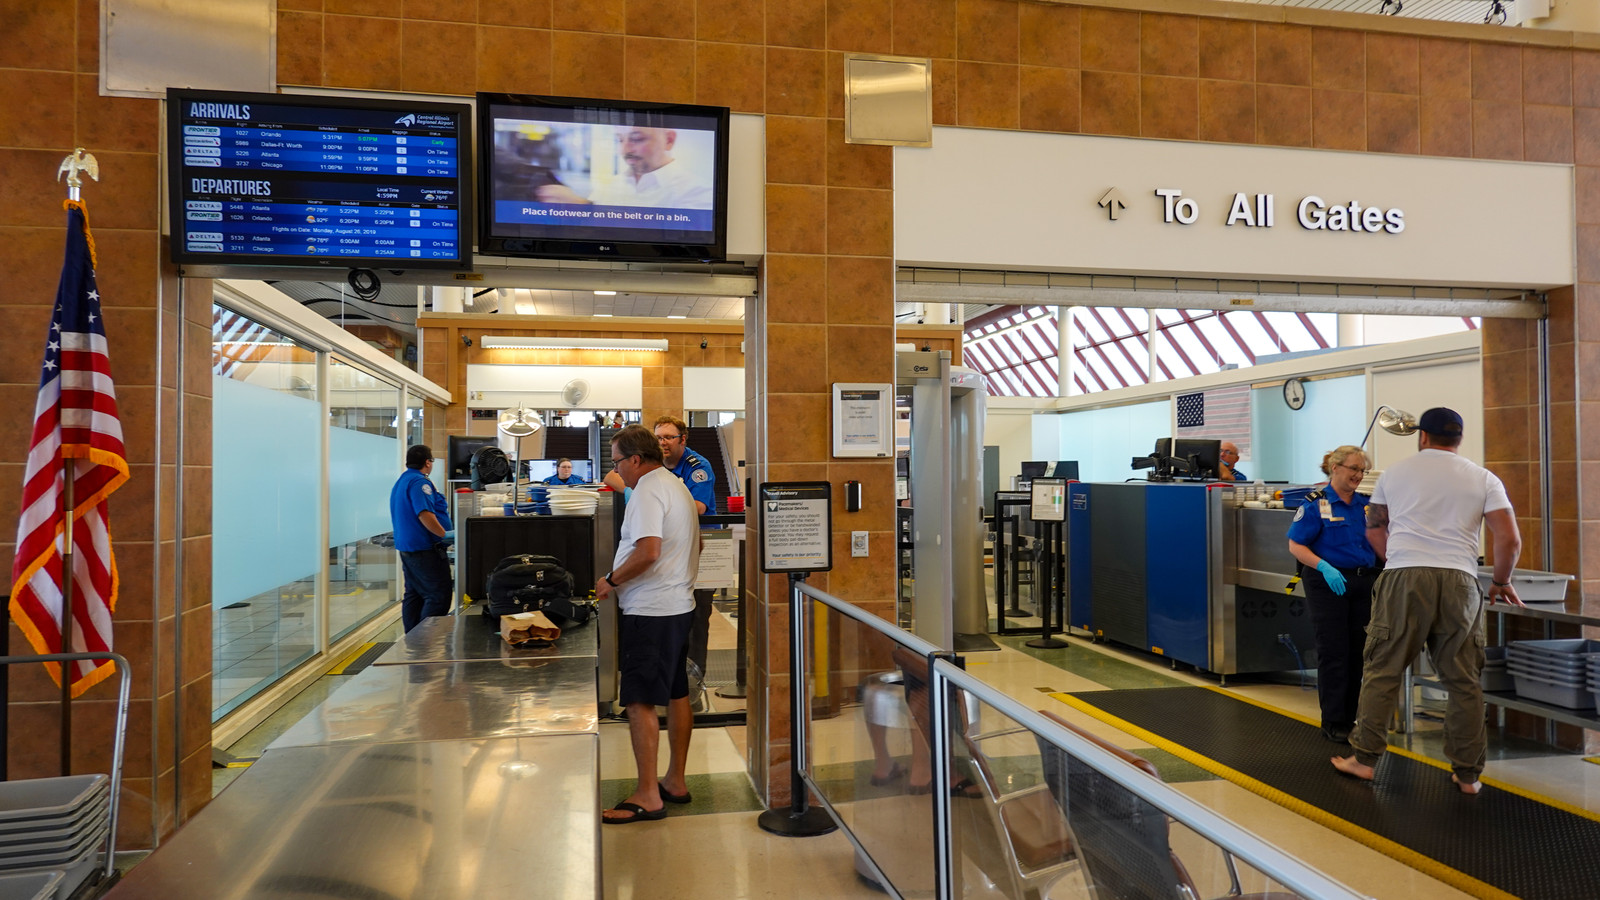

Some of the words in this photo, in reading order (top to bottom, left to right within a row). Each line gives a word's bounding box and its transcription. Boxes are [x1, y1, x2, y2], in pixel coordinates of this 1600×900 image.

[190, 102, 251, 120] ARRIVALS
[192, 177, 272, 196] DEPARTURES
[522, 207, 547, 216] Place
[549, 208, 591, 218] footwear
[607, 210, 622, 219] the
[624, 211, 642, 220] belt
[643, 213, 654, 221] or
[655, 213, 665, 221] in
[673, 213, 691, 222] bin.
[1155, 188, 1199, 225] To
[1226, 192, 1274, 228] All
[1298, 195, 1406, 234] Gates
[959, 375, 964, 384] 2
